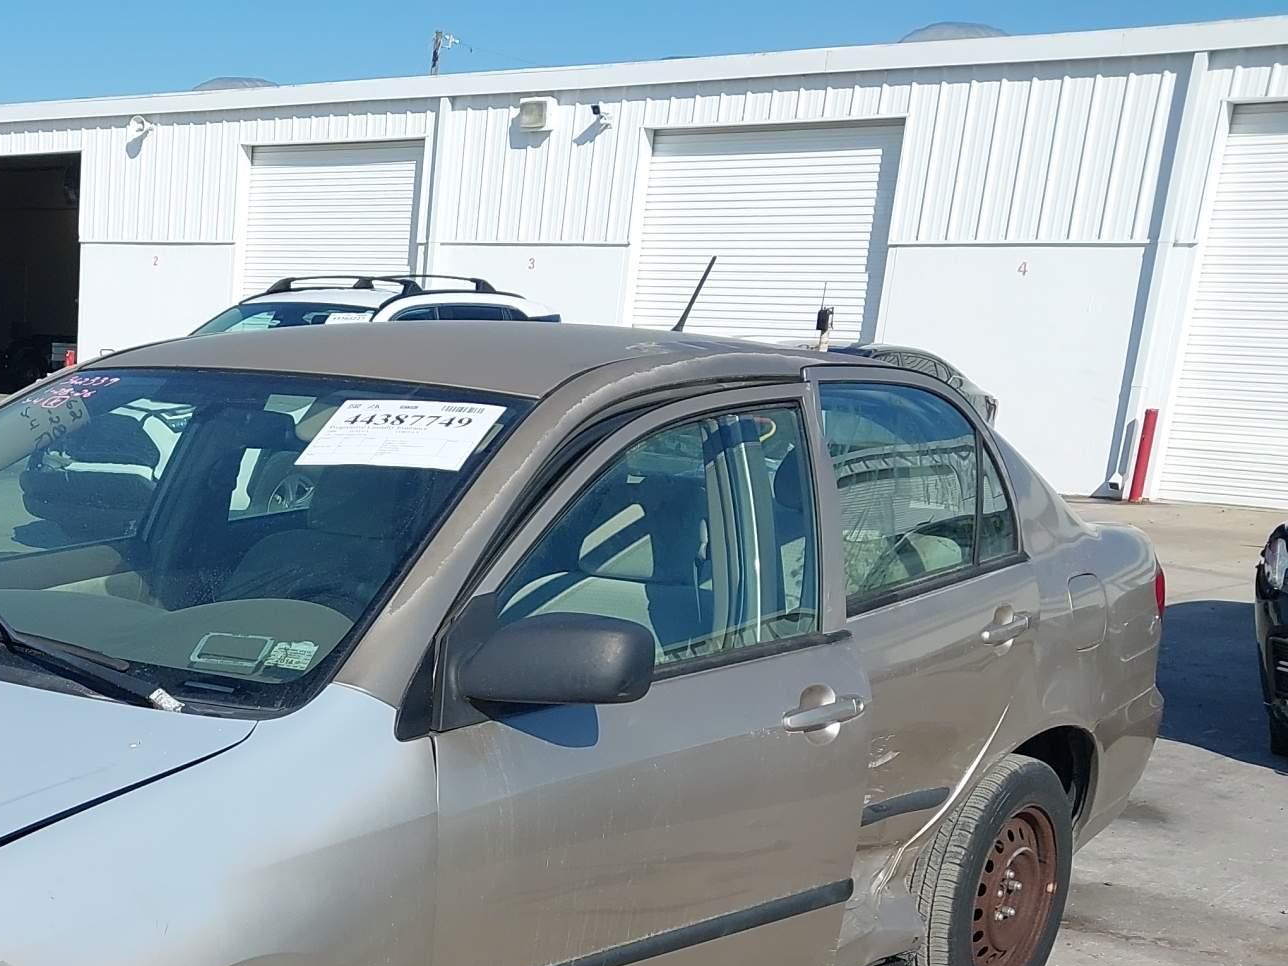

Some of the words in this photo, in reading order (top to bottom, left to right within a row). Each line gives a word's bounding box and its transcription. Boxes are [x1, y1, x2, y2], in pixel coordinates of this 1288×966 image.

[152, 255, 159, 266] 2
[527, 257, 536, 270] 3
[1016, 261, 1028, 277] 4
[344, 413, 473, 429] 44387749
